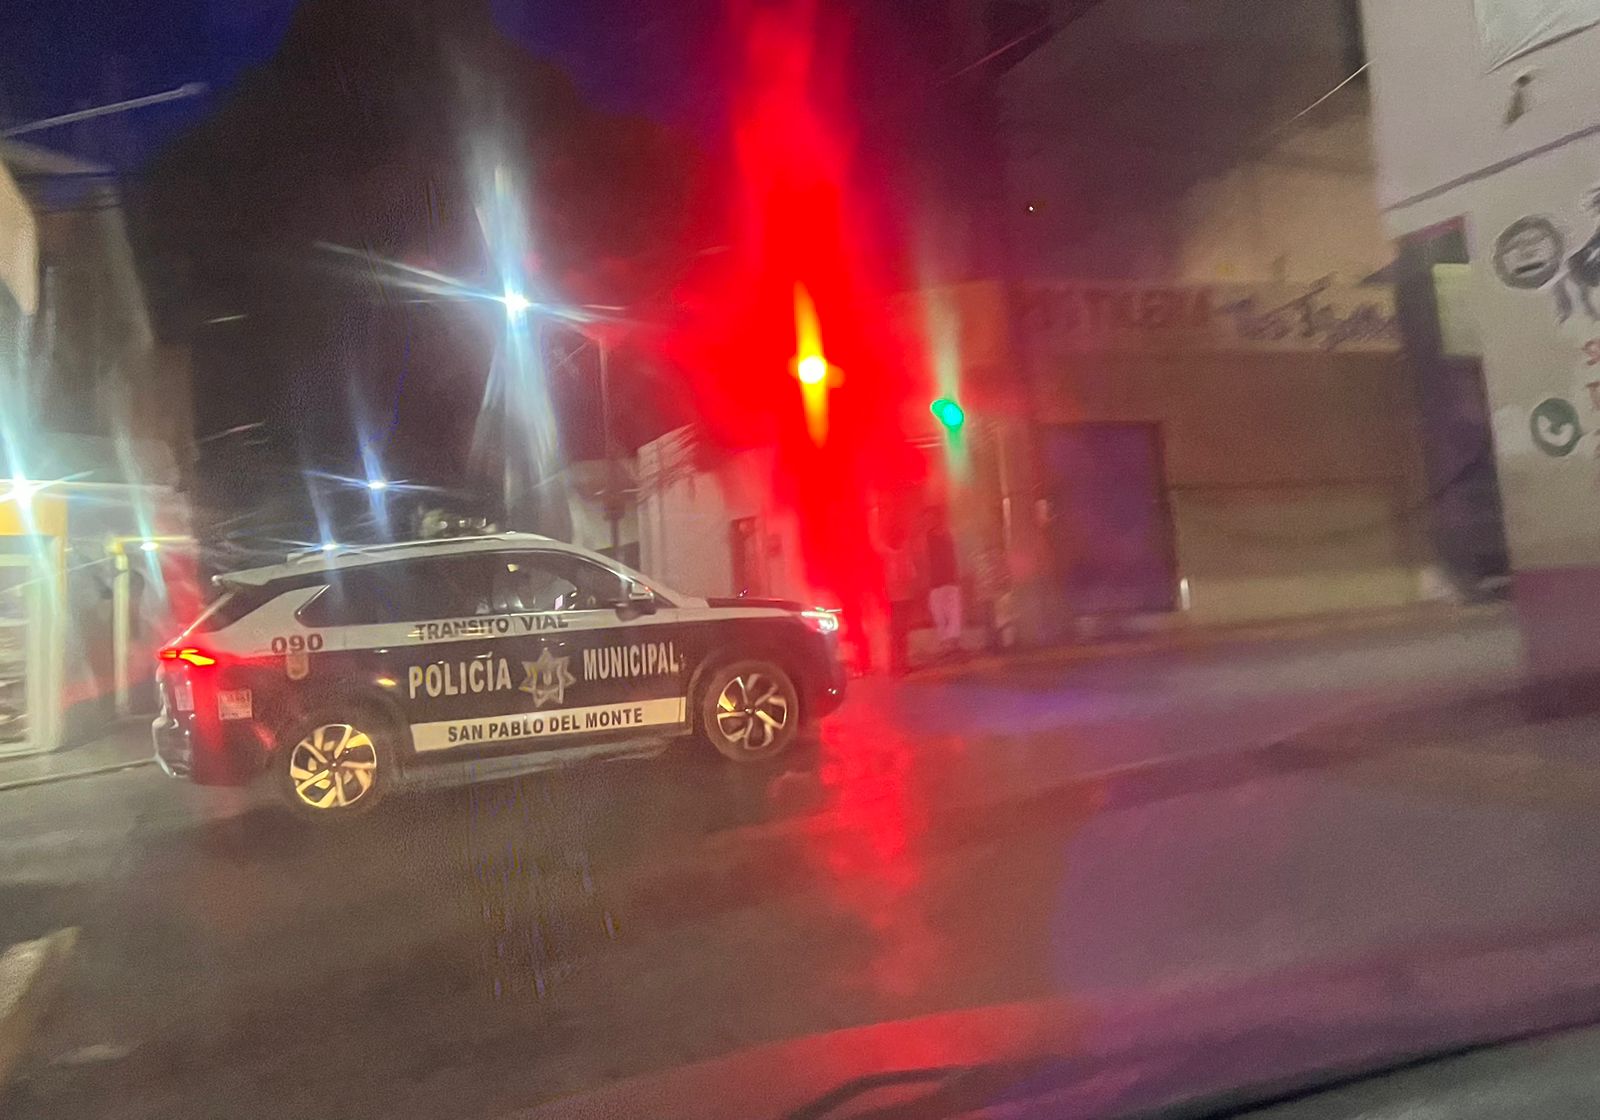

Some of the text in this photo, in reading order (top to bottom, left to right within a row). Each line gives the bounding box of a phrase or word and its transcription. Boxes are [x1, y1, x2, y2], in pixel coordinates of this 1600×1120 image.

[414, 612, 569, 641] TRANSITO VIAL
[271, 633, 323, 654] 090
[408, 641, 679, 699] POLICÍA MUNICIPAL
[447, 707, 643, 743] SAN PABLO DEL MONTE
